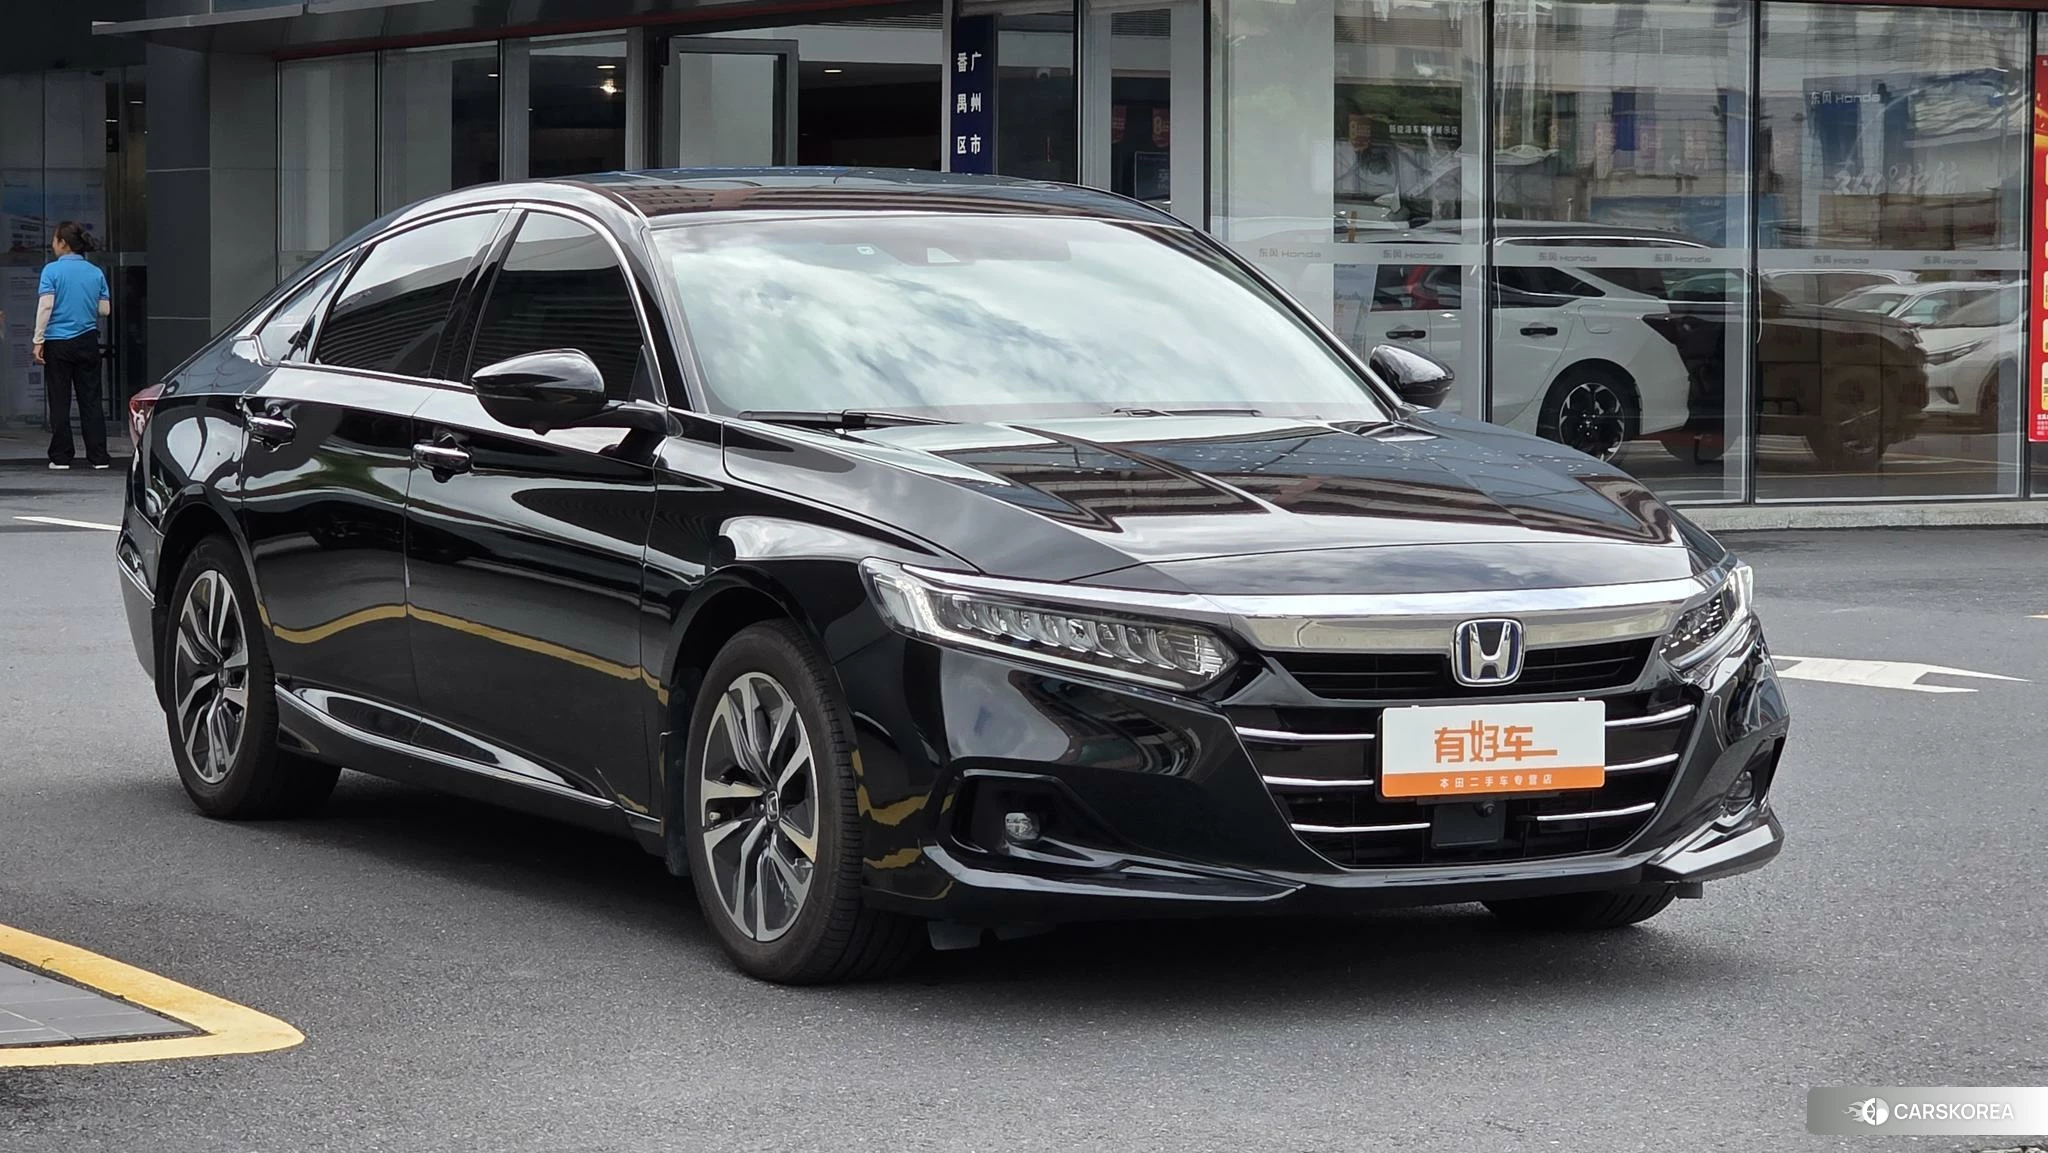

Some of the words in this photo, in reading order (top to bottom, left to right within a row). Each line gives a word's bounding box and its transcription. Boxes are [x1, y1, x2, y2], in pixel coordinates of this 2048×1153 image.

[956, 52, 967, 155] 番禺区
[970, 52, 982, 155] 广州市
[1281, 250, 1321, 258] Honda
[1404, 252, 1444, 260] Honda
[1434, 719, 1558, 764] 有好车
[1439, 773, 1554, 789] 本田二手车专营店
